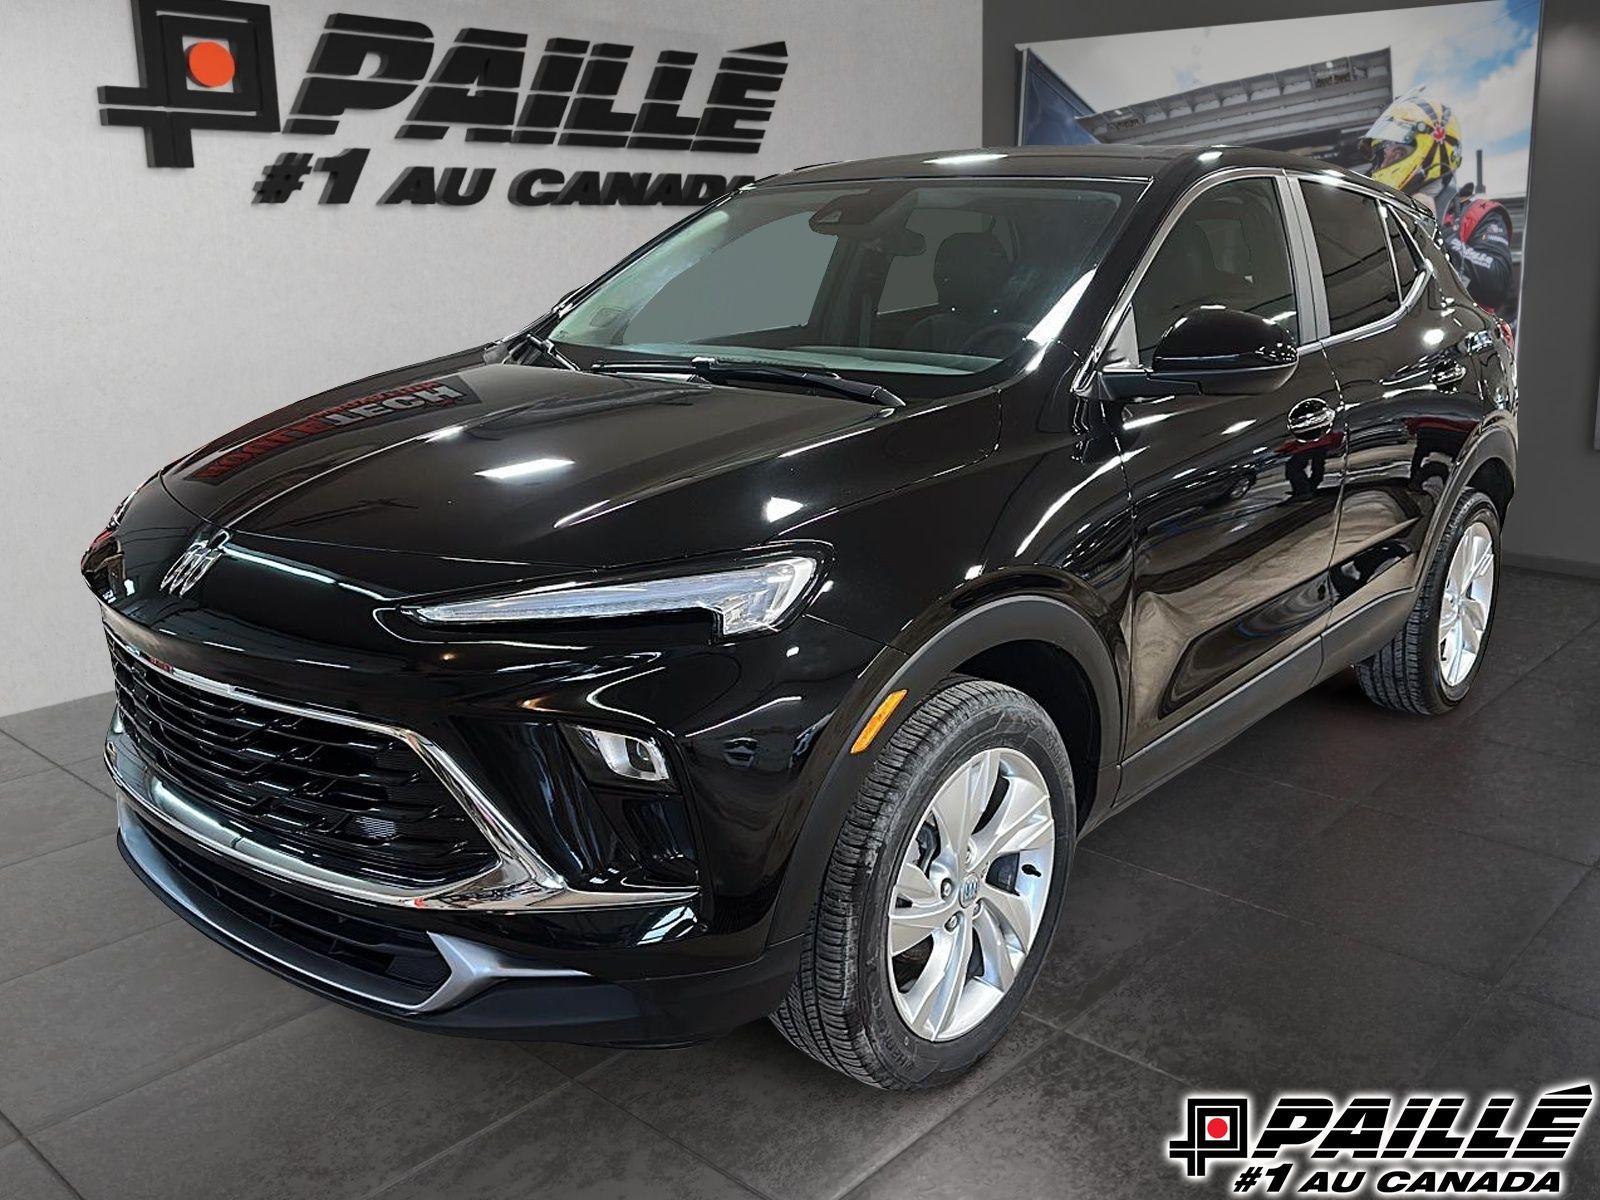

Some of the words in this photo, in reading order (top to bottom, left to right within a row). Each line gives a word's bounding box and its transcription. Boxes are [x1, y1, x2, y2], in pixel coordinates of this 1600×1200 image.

[281, 13, 788, 154] PAILLÉ
[252, 148, 371, 205] #1
[376, 166, 497, 206] AU
